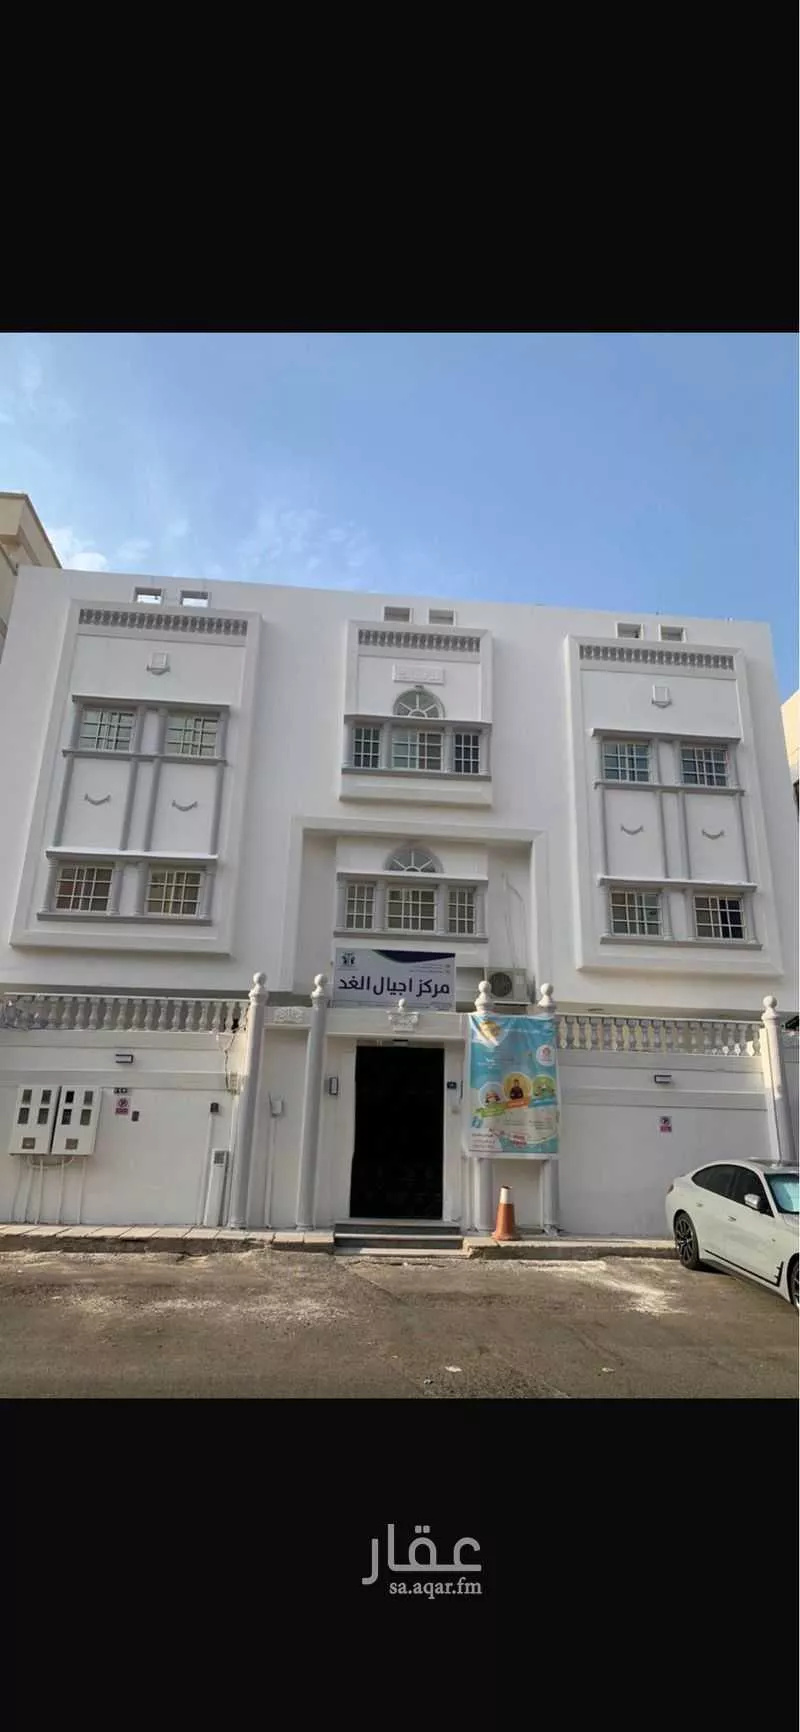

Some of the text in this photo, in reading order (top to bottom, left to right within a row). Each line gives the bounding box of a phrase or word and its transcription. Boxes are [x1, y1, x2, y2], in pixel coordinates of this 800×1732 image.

[338, 975, 450, 998] مركز اجيال الغد
